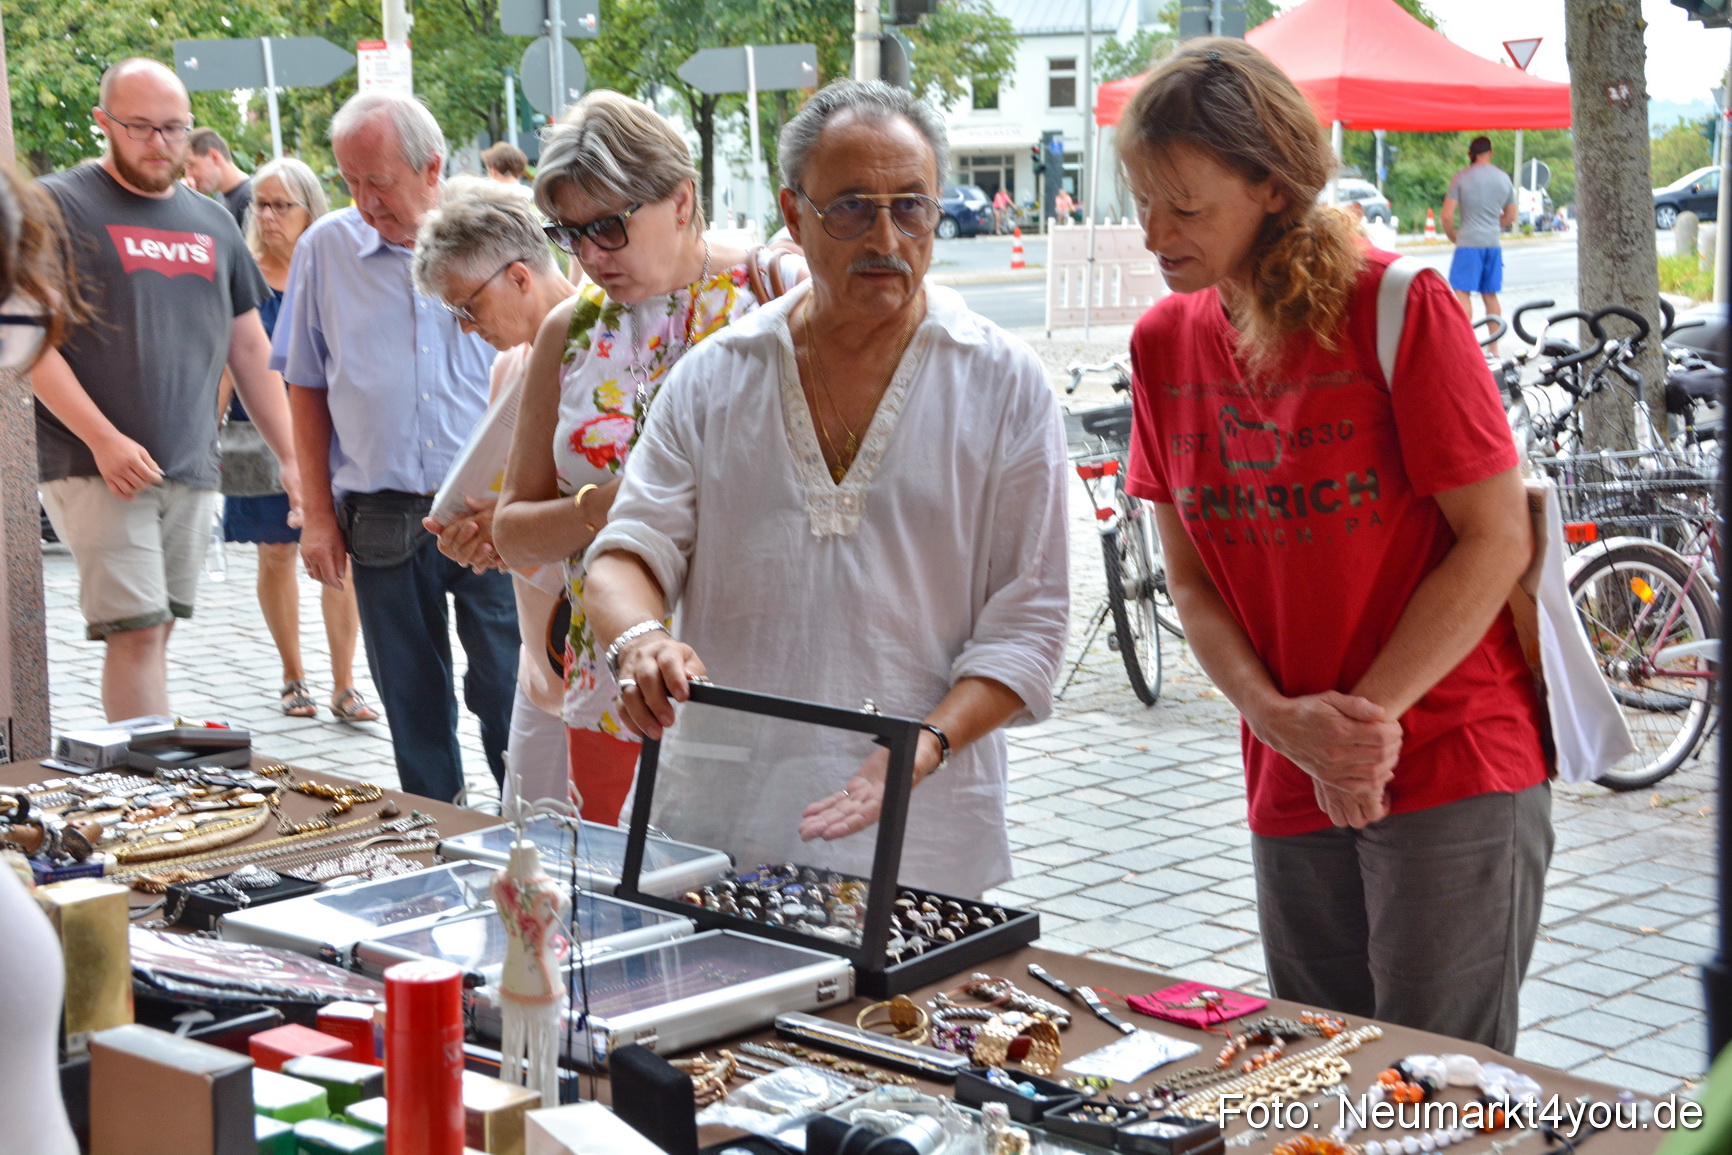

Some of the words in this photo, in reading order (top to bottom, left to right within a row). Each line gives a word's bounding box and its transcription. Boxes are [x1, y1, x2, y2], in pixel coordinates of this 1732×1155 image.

[1287, 419, 1354, 451] 1830
[1173, 467, 1380, 521] ENN-RICH
[1345, 511, 1383, 536] PA
